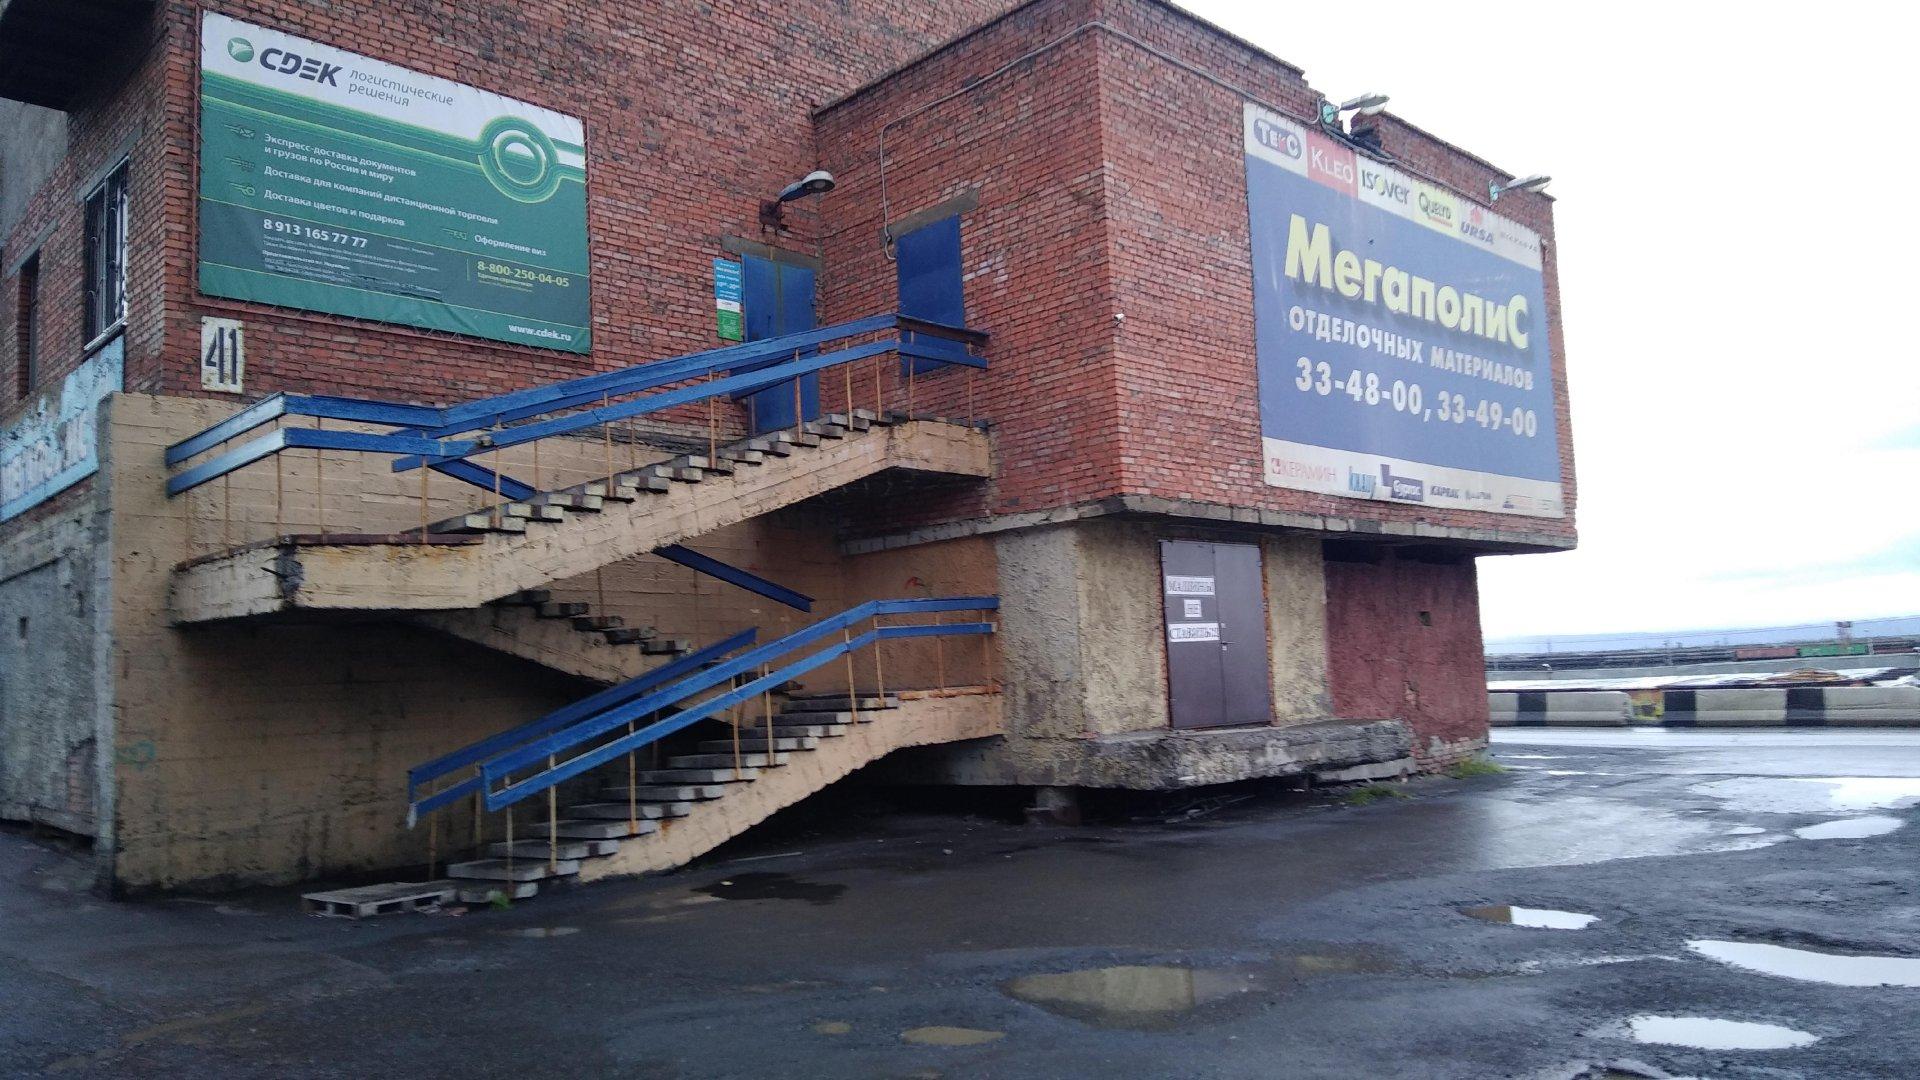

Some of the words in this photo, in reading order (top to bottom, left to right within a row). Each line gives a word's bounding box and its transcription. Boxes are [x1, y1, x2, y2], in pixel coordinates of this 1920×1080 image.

[259, 47, 343, 88] CDEK
[348, 83, 410, 107] решения
[349, 69, 454, 106] логистические
[264, 133, 358, 163] Экспресс-доставка
[359, 157, 417, 177] документов
[273, 148, 308, 163] грузов
[309, 156, 323, 166] по
[324, 158, 360, 175] России
[360, 168, 367, 176] и
[368, 170, 394, 183] миру
[1311, 146, 1354, 184] KLEO
[264, 166, 312, 184] Доставка
[313, 178, 332, 188] для
[333, 183, 383, 199] компаний
[383, 194, 456, 215] дистанционной
[457, 210, 498, 225] торговли
[264, 189, 312, 207] Доставка
[313, 201, 349, 216] цветов
[350, 207, 357, 215] и
[358, 210, 405, 226] подарков
[263, 219, 273, 230] 8
[275, 220, 301, 236] 913
[305, 226, 330, 242] 165
[331, 231, 349, 245] 77
[350, 236, 368, 248] 77
[474, 234, 531, 254] Оформление
[531, 247, 547, 257] виз
[1461, 221, 1494, 245] URSA
[477, 260, 570, 288] 8-800-250-04-05
[508, 324, 572, 342] www.cdek.ru
[1289, 305, 1424, 364] ОТДЕЛОЧНЫХ
[1430, 345, 1534, 391] МАТЕРИАЛОВ
[205, 326, 237, 385] 41
[1295, 356, 1431, 423] 33-48-00,
[1437, 390, 1538, 438] 33-49-00
